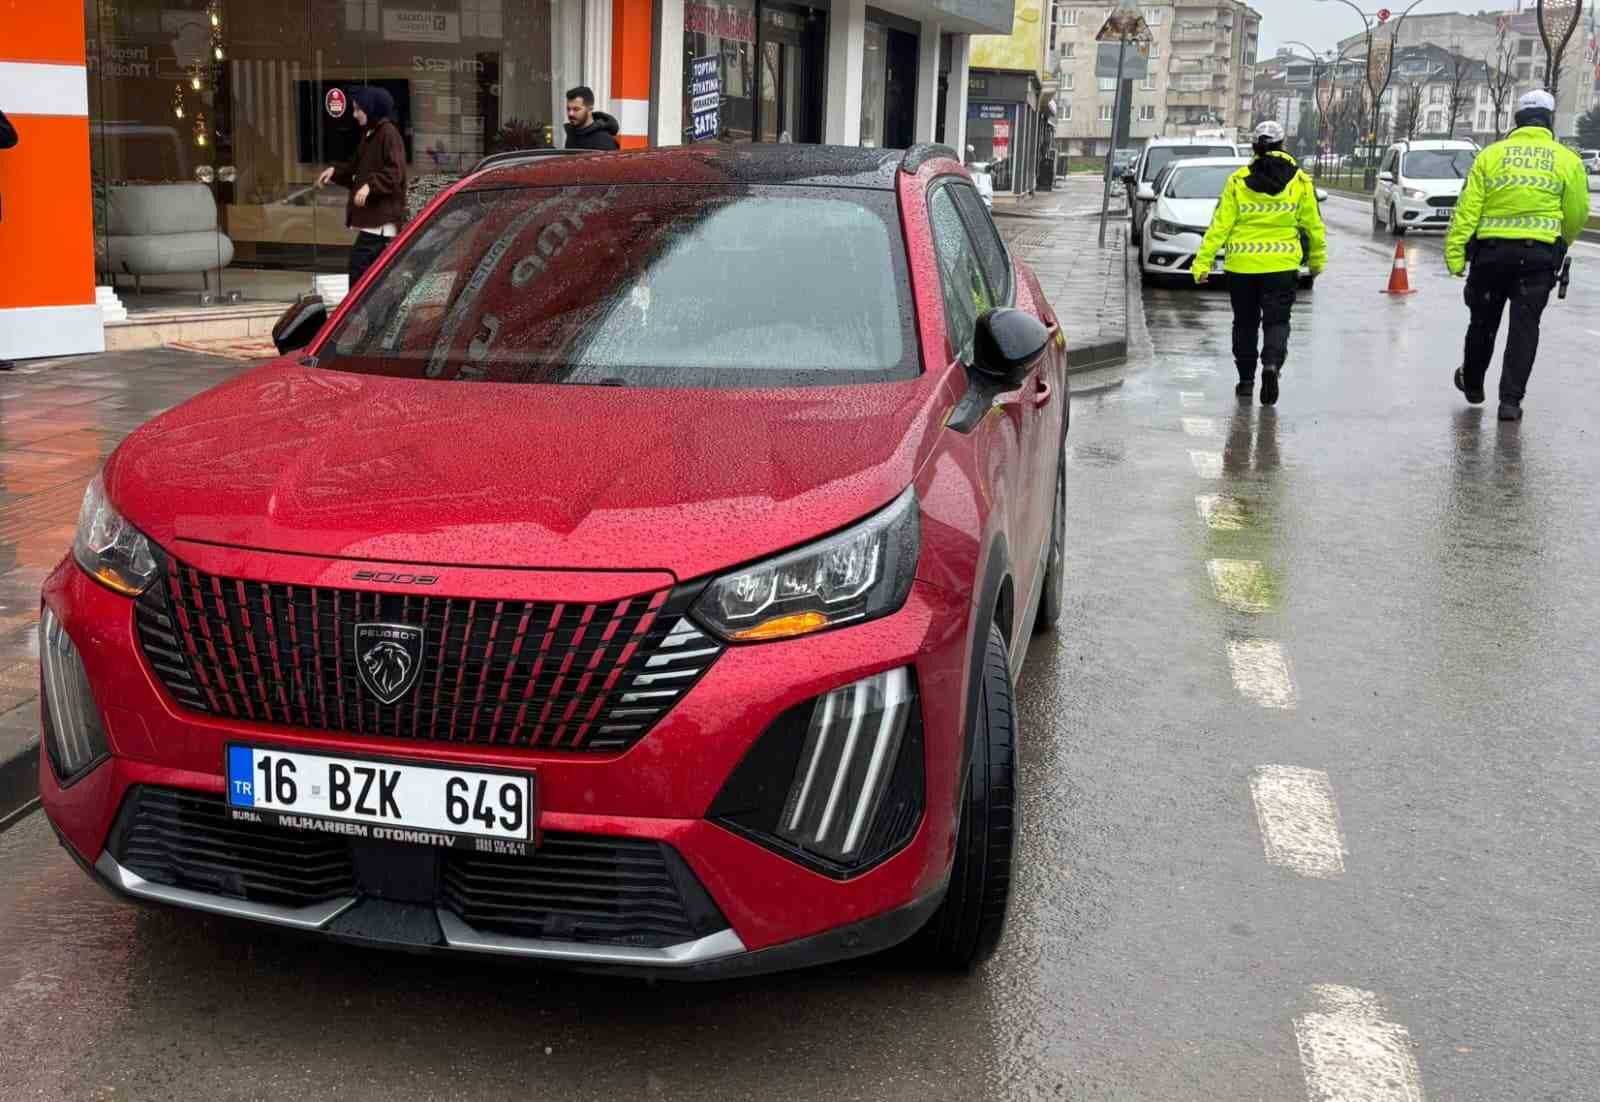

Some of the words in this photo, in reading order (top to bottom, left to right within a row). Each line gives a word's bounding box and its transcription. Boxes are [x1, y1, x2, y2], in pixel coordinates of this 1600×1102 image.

[694, 60, 717, 76] TOPTAN
[694, 112, 718, 136] SATIŞ
[352, 571, 438, 585] 2008
[360, 629, 417, 640] PEUGEOT
[234, 780, 252, 796] TR
[257, 755, 298, 806] 16
[328, 763, 402, 819] BZK
[446, 776, 523, 832] 649
[232, 810, 262, 823] BURSA
[279, 815, 368, 838] MUHARREM
